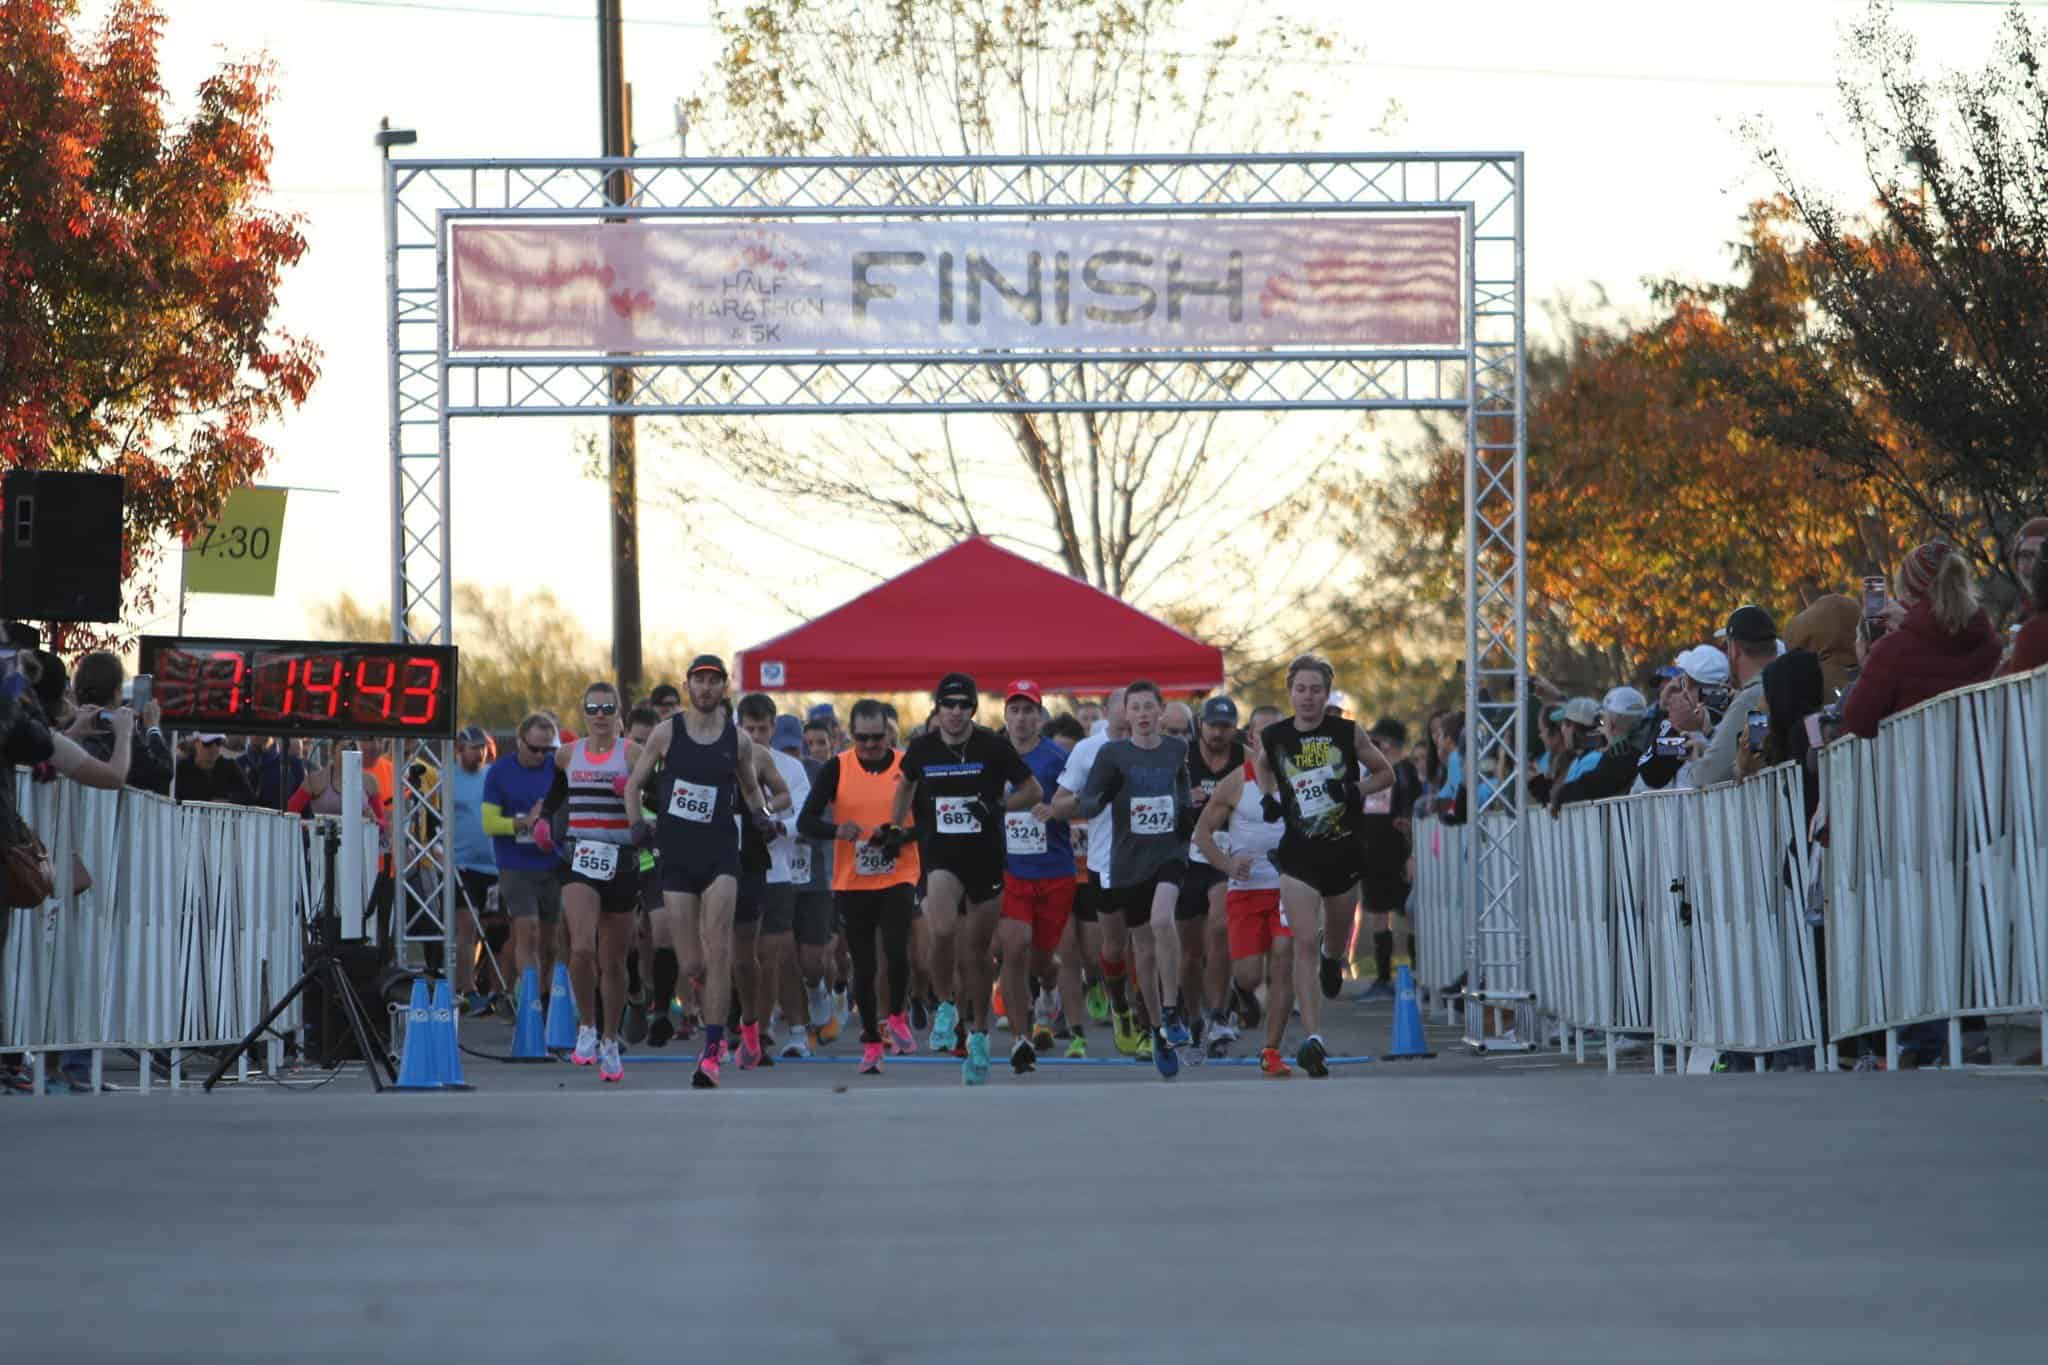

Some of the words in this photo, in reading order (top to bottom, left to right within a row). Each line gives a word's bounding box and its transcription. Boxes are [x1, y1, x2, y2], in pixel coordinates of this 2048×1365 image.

[851, 250, 1243, 326] FINISH
[751, 324, 781, 342] 5K
[200, 525, 270, 560] 7:30
[212, 652, 440, 725] 7:14:43
[676, 796, 709, 814] 668
[943, 811, 972, 825] 687
[1138, 812, 1168, 825] 247
[1011, 826, 1040, 839] 324
[579, 856, 610, 871] 555
